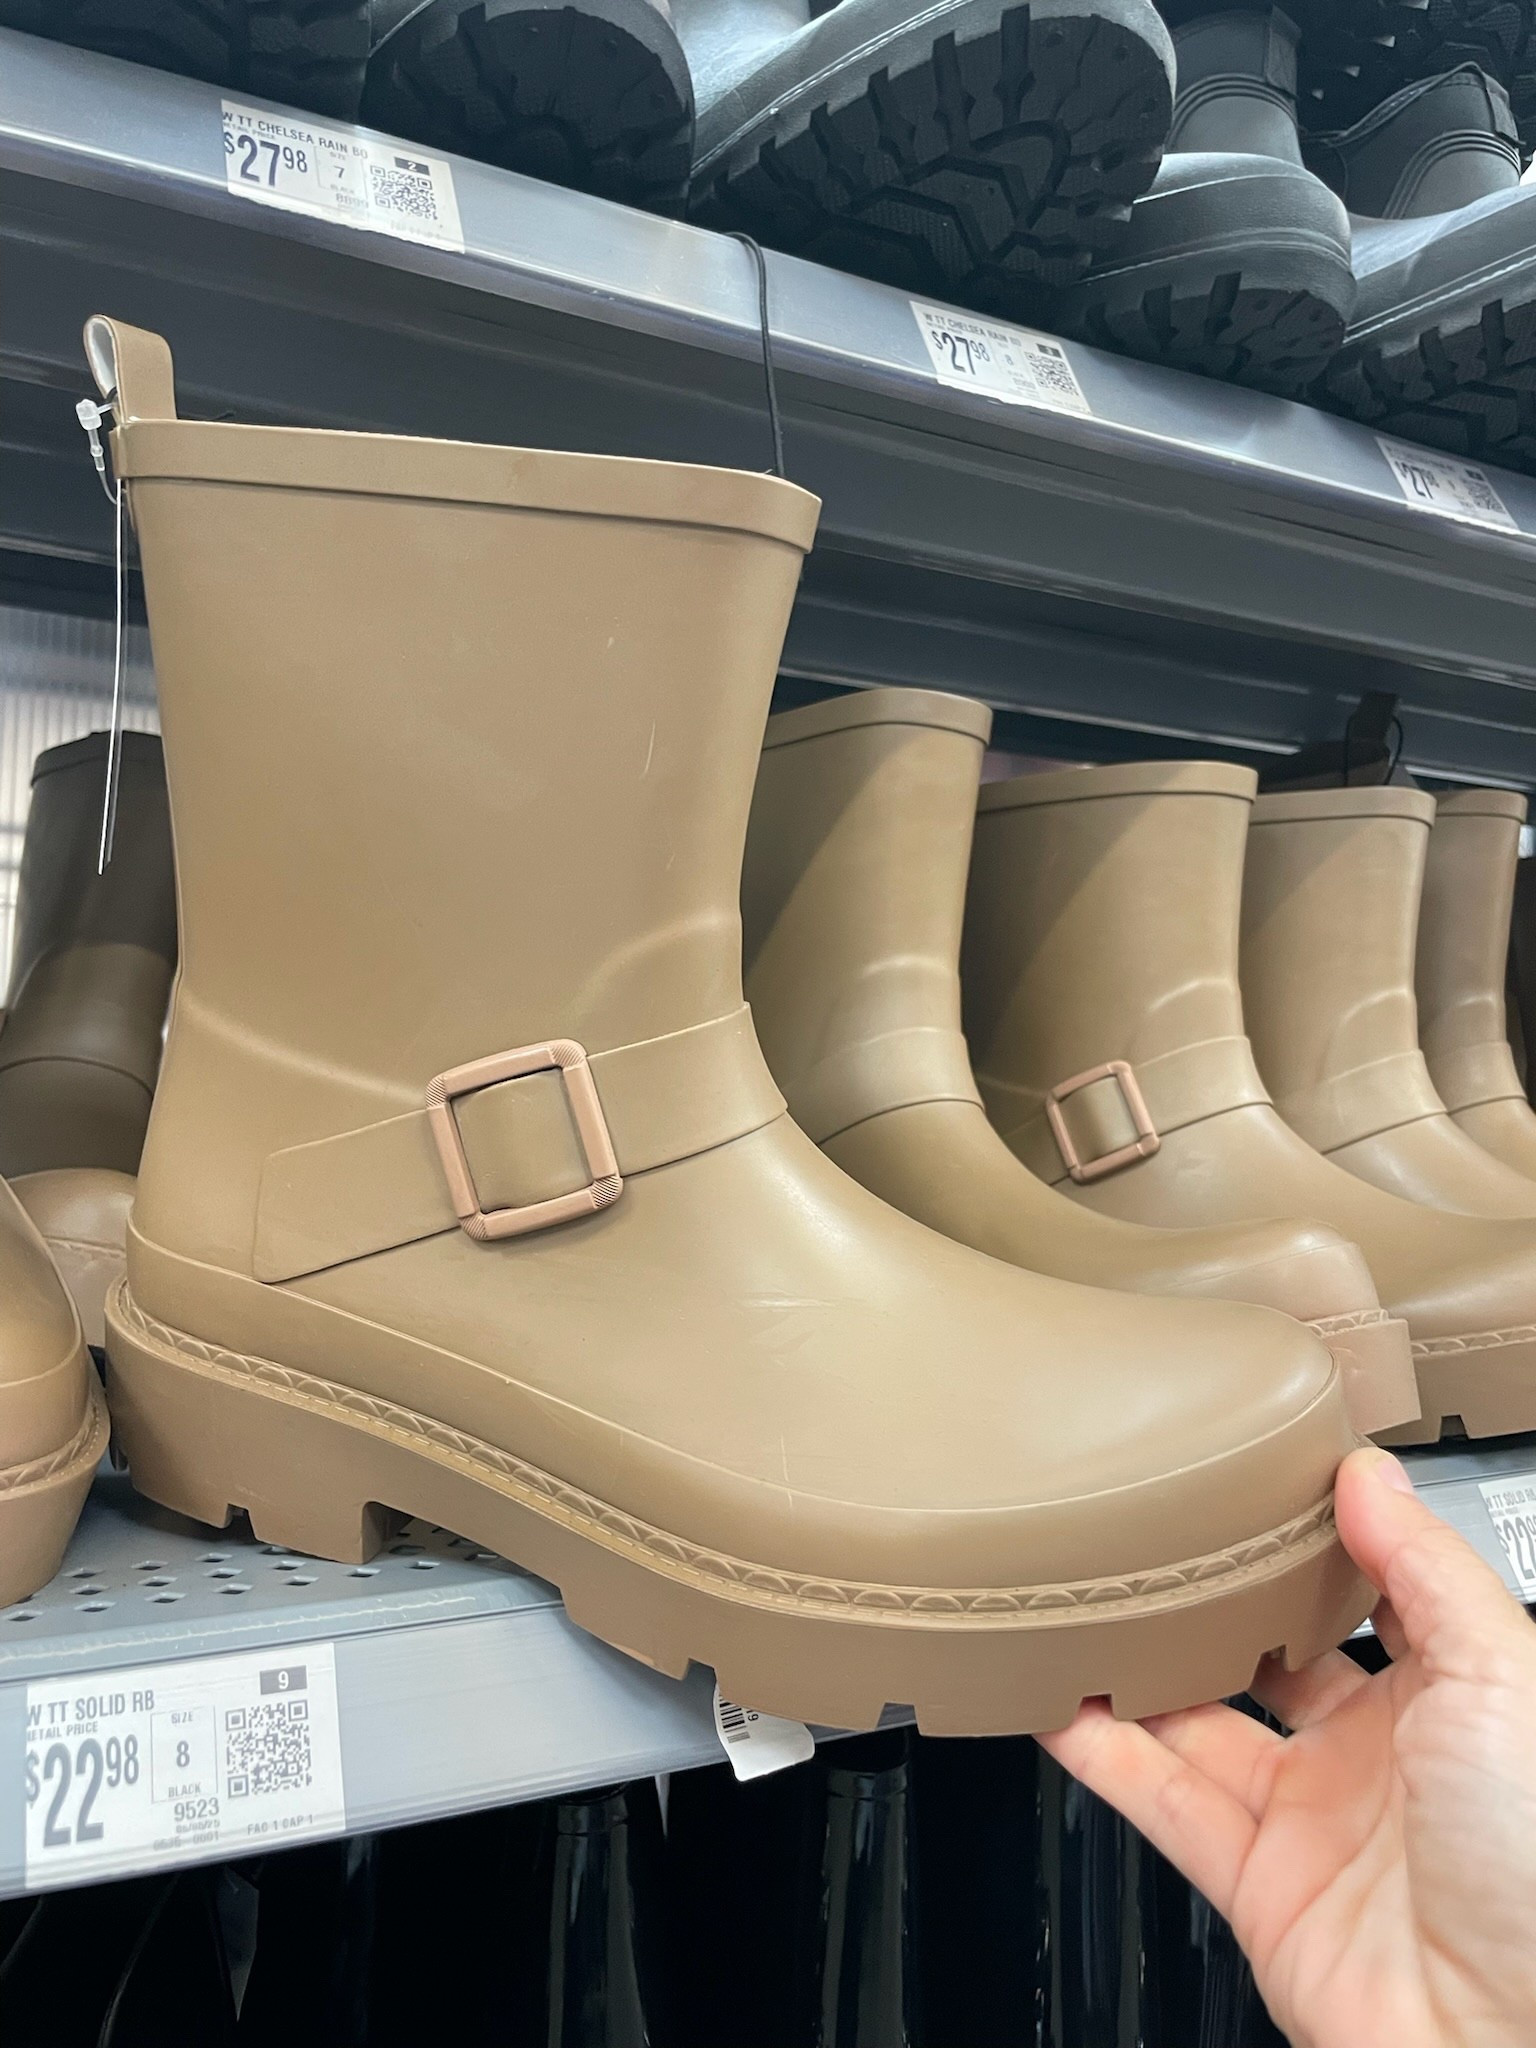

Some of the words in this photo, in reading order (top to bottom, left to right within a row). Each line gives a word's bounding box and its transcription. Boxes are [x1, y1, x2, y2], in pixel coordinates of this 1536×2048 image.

[238, 115, 252, 127] TT
[257, 120, 315, 144] CHELSEA
[318, 137, 348, 154] RAIN
[333, 165, 345, 179] 7
[407, 161, 417, 172] 2
[949, 319, 987, 337] CHELSEA
[277, 1671, 290, 1690] 9
[27, 1703, 42, 1727] W
[47, 1701, 70, 1722] TT
[75, 1693, 126, 1721] SOLID
[132, 1689, 155, 1713] RB
[171, 1711, 194, 1725] SIZE
[66, 1721, 99, 1737] PRICE
[175, 1740, 191, 1769] 8
[168, 1783, 202, 1799] BLACK
[174, 1797, 220, 1823] 9523
